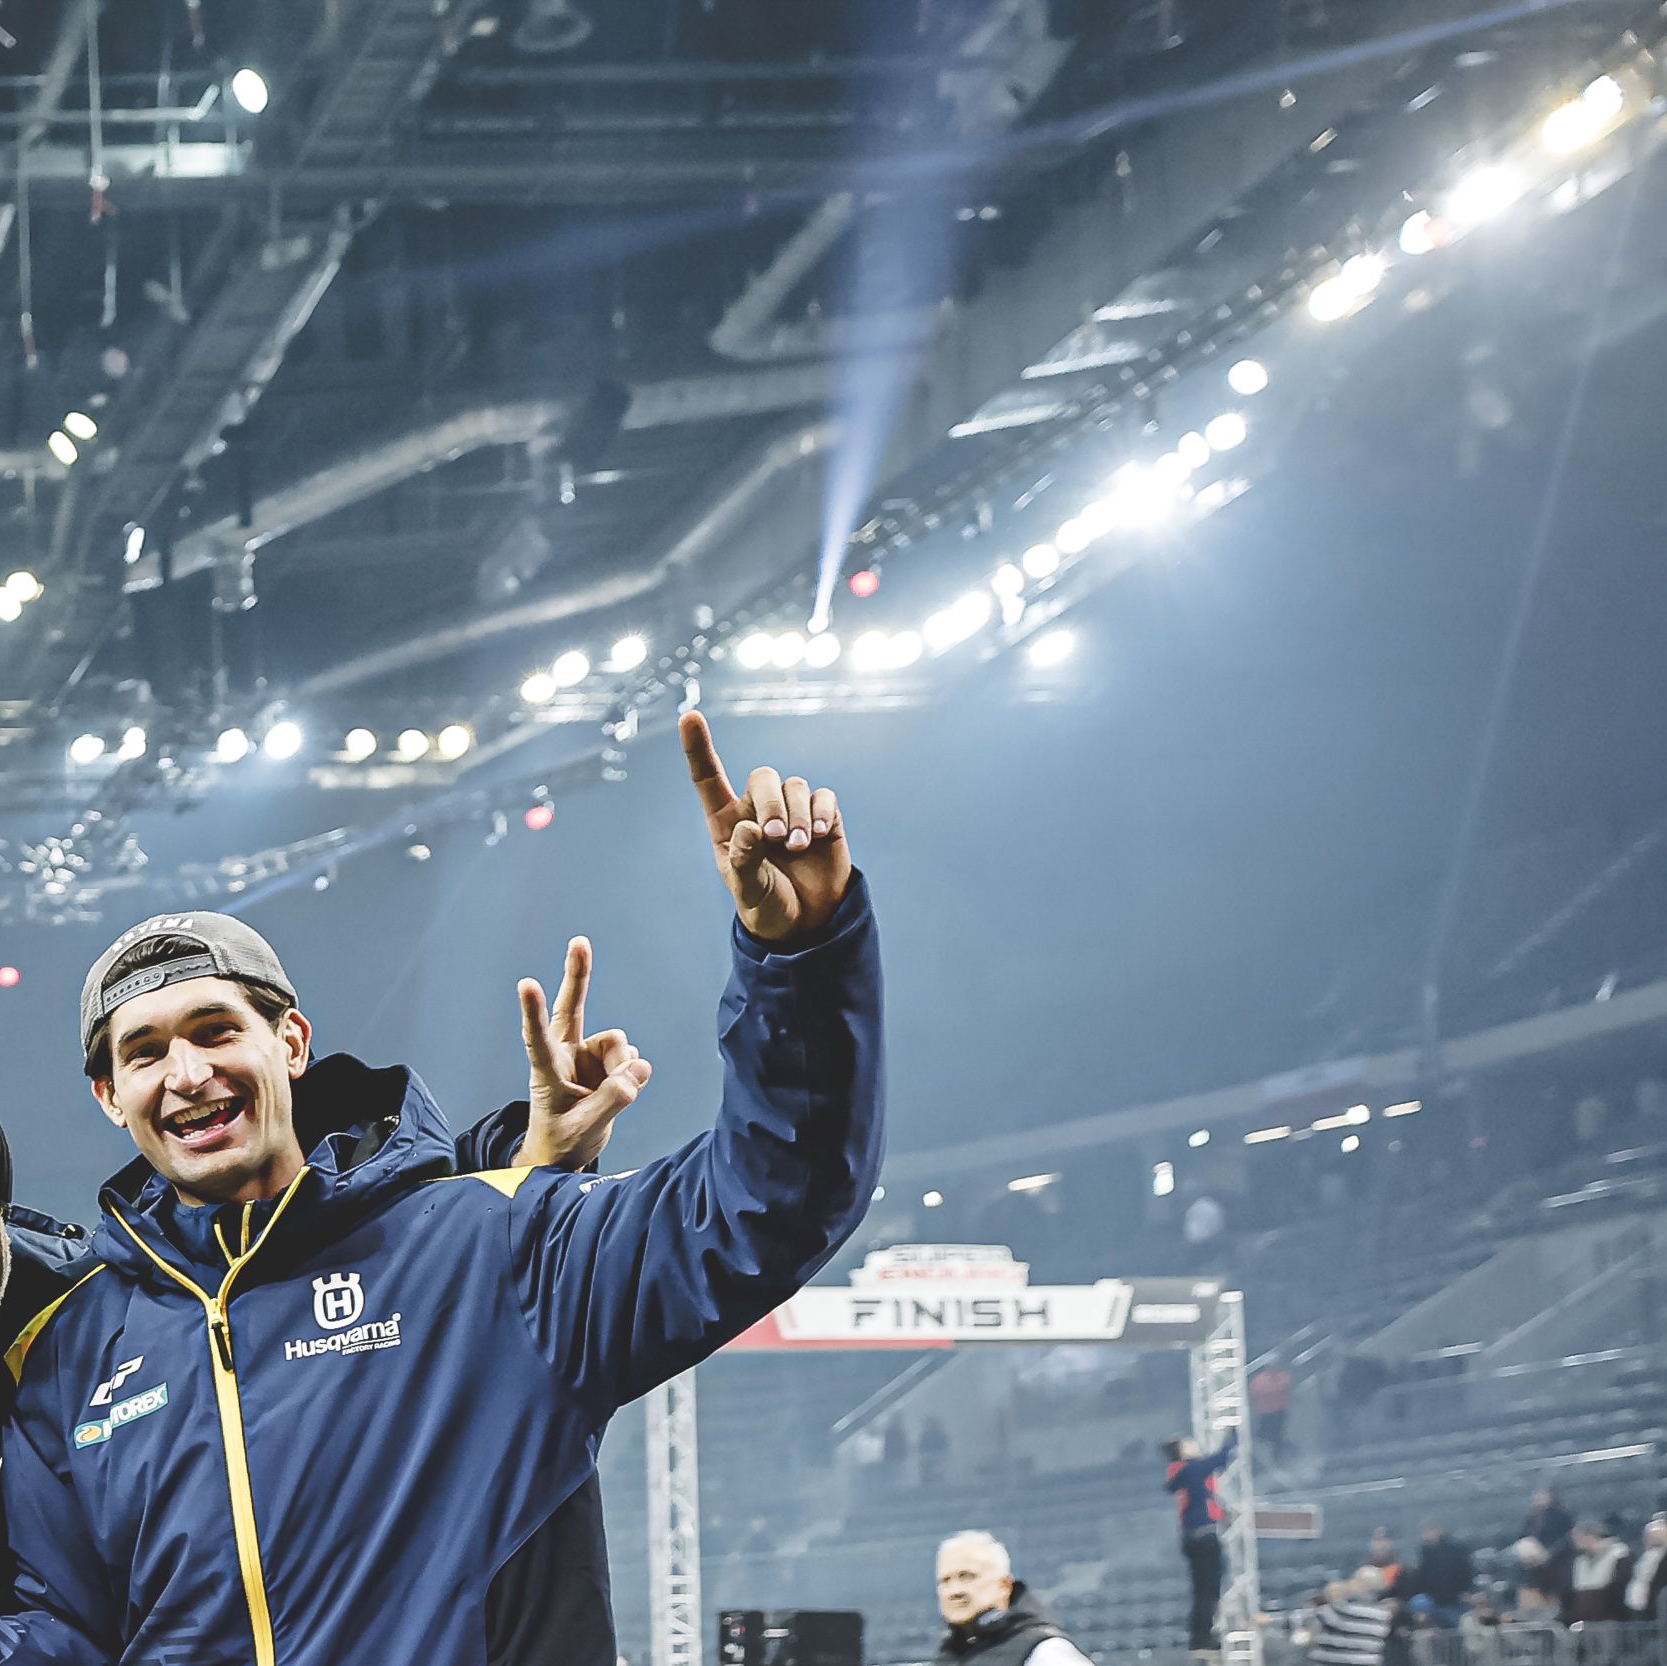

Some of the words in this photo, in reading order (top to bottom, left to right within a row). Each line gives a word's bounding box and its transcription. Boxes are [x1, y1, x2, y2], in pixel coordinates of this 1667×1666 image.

[852, 1299, 1051, 1328] FINISH
[285, 1320, 399, 1360] Husqvarna
[342, 1343, 373, 1355] FACTORY
